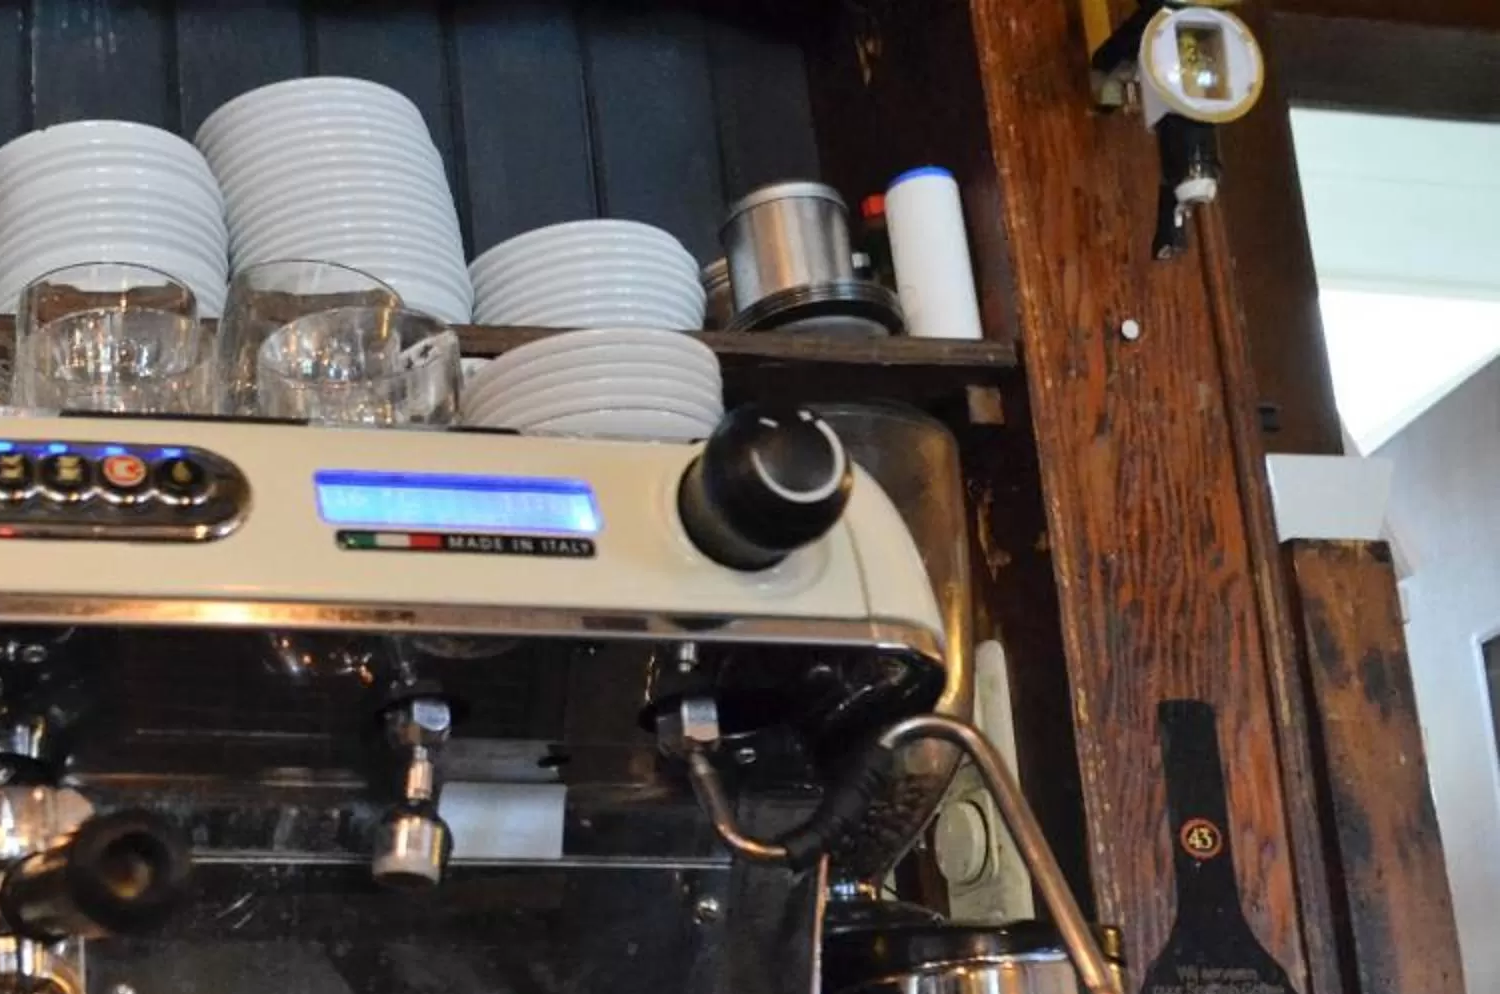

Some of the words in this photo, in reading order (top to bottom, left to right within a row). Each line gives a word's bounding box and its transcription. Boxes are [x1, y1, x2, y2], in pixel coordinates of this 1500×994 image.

[449, 535, 504, 550] MADE
[512, 539, 534, 551] IN
[541, 540, 590, 553] ITALY
[1187, 828, 1213, 849] 43
